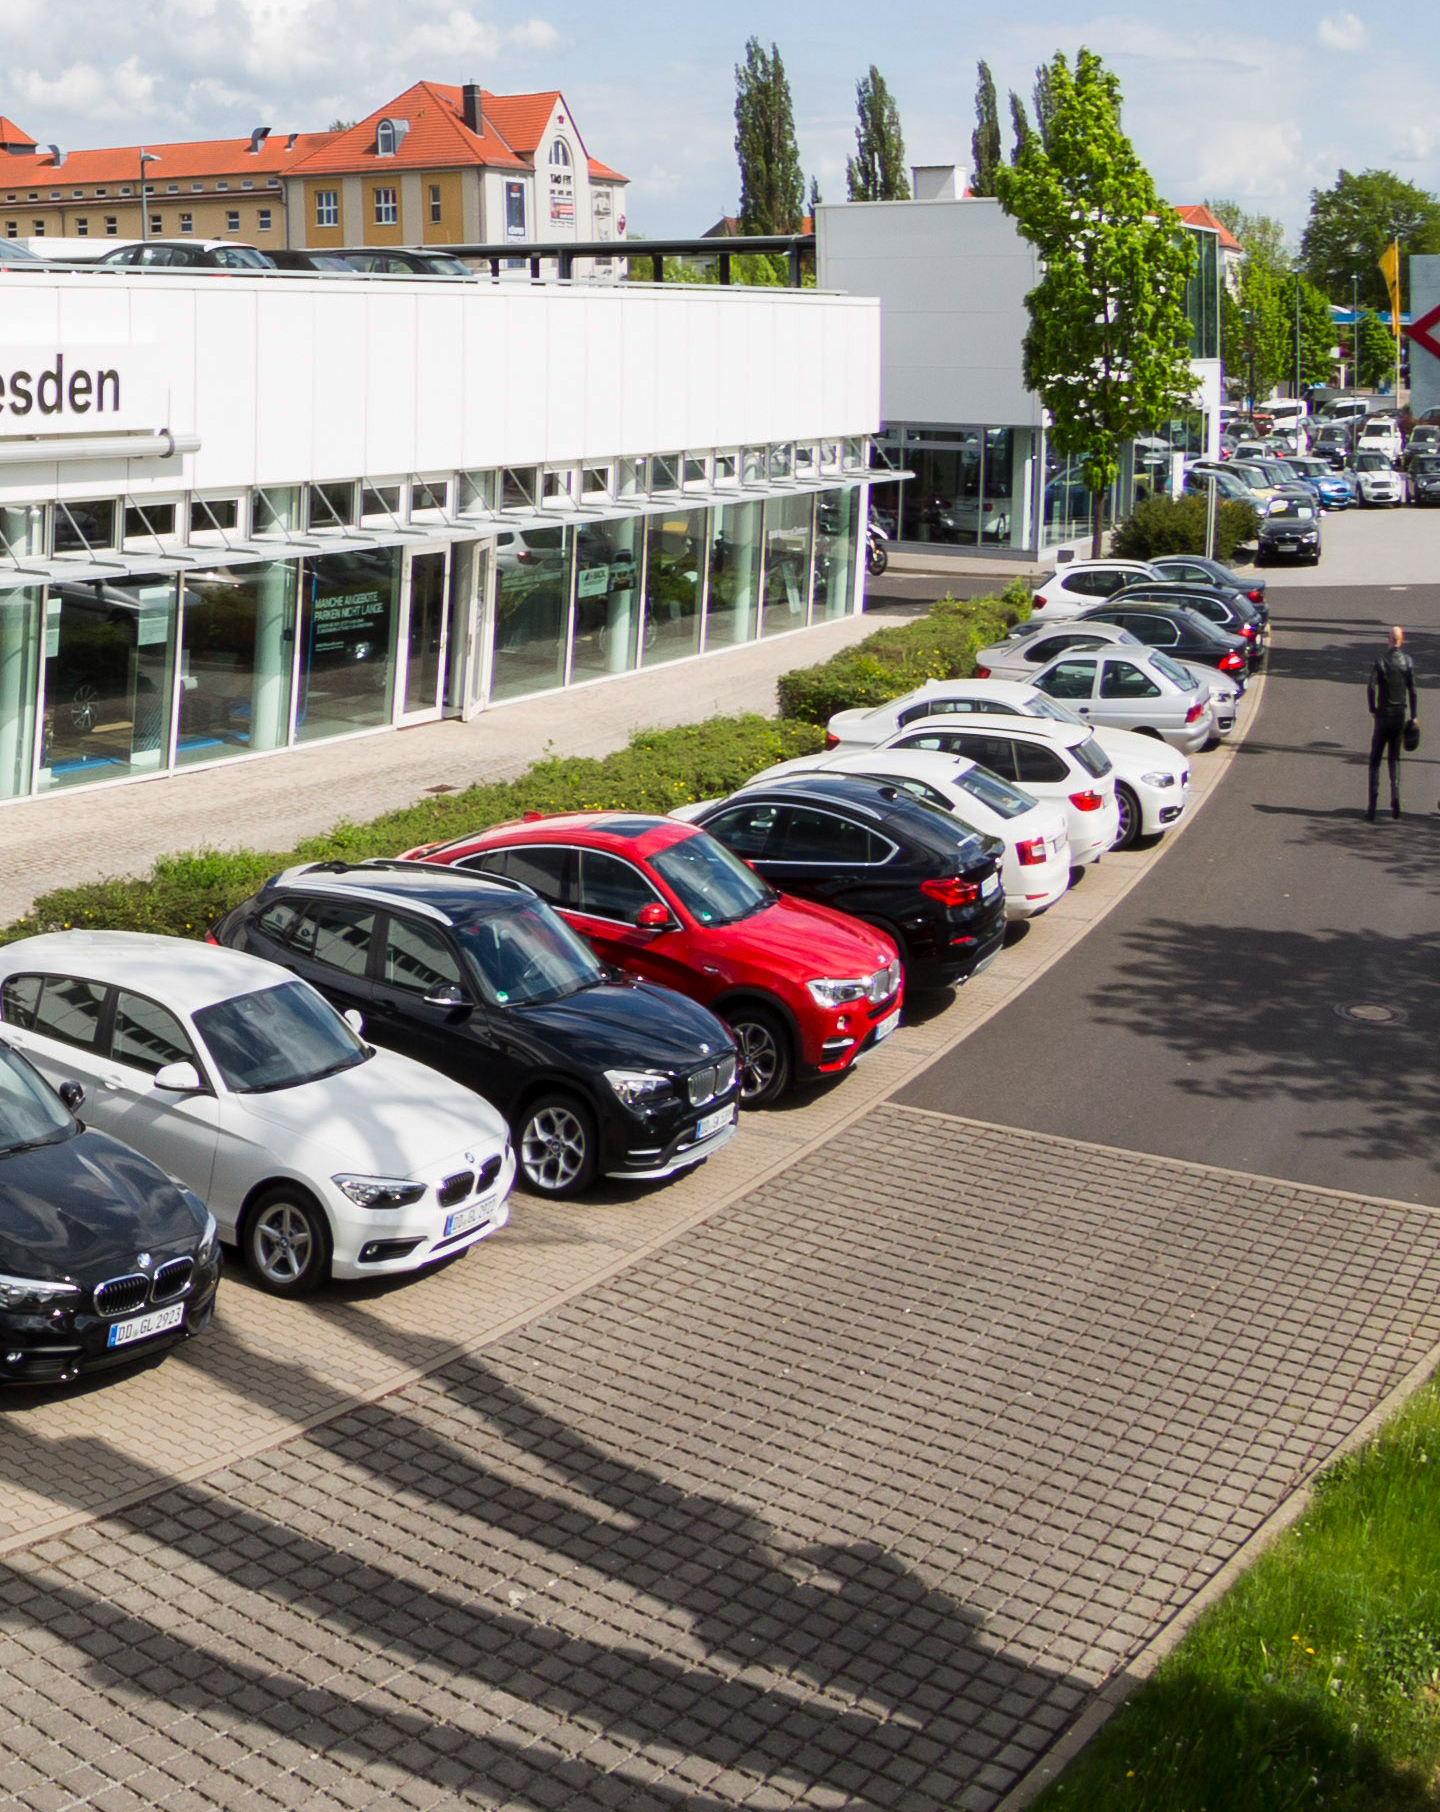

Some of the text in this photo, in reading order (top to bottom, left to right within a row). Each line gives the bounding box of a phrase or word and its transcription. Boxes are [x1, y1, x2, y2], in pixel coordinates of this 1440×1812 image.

[316, 591, 379, 610] MANCHE ANGEBOTE
[315, 608, 341, 621] PARKEN
[341, 605, 361, 618] NICHT
[118, 1306, 182, 1341] DD GL 2923
